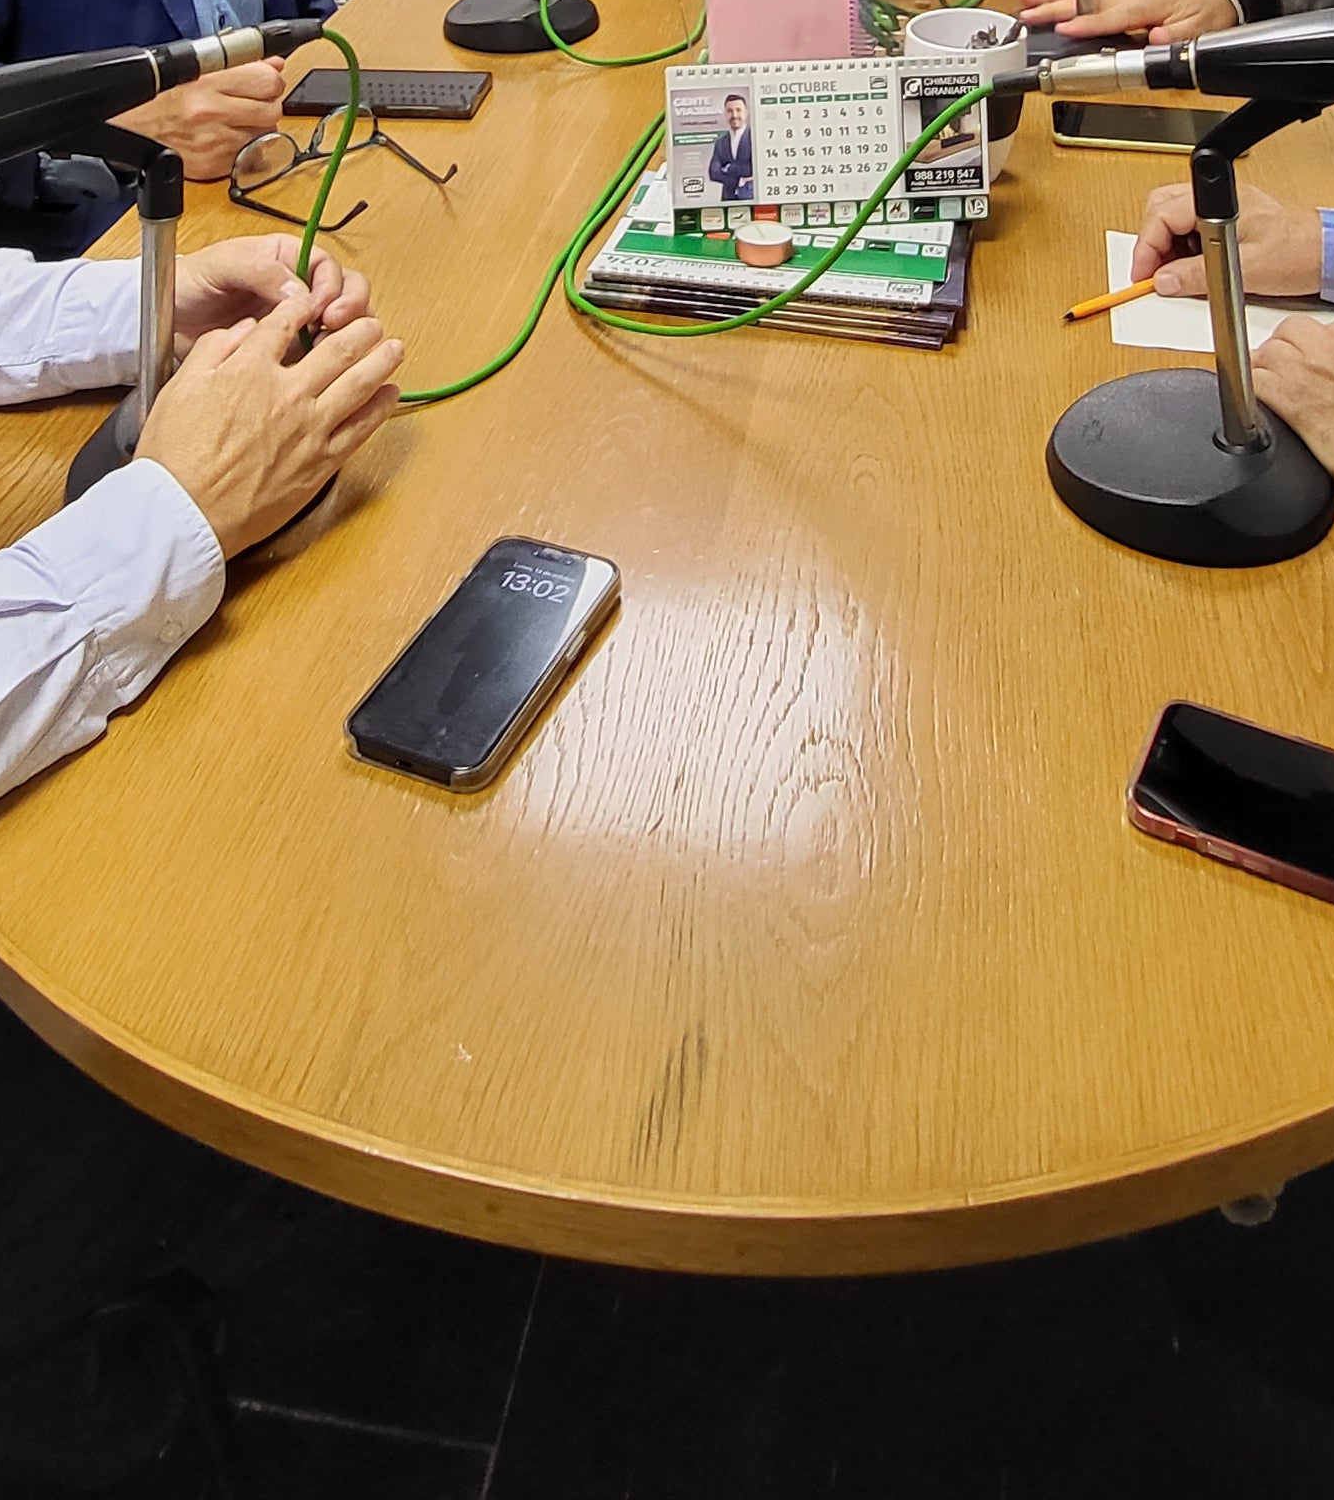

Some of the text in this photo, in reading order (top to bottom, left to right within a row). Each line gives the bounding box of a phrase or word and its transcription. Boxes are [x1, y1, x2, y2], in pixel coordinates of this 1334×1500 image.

[923, 75, 978, 86] CHIMENEAS
[779, 81, 837, 94] OCTUBRE
[820, 127, 832, 137] 10
[839, 126, 850, 136] 11
[857, 126, 868, 135] 12
[875, 125, 886, 134] 13
[766, 144, 888, 158] 14 15 16 17 18 19 20
[767, 162, 888, 177] 21 22 23 24 25 26 27
[935, 170, 954, 179] 219
[957, 168, 975, 178] 547
[767, 186, 780, 196] 28
[785, 185, 798, 195] 29
[803, 184, 817, 194] 30
[822, 183, 834, 193] 31
[501, 570, 570, 603] 13:02
